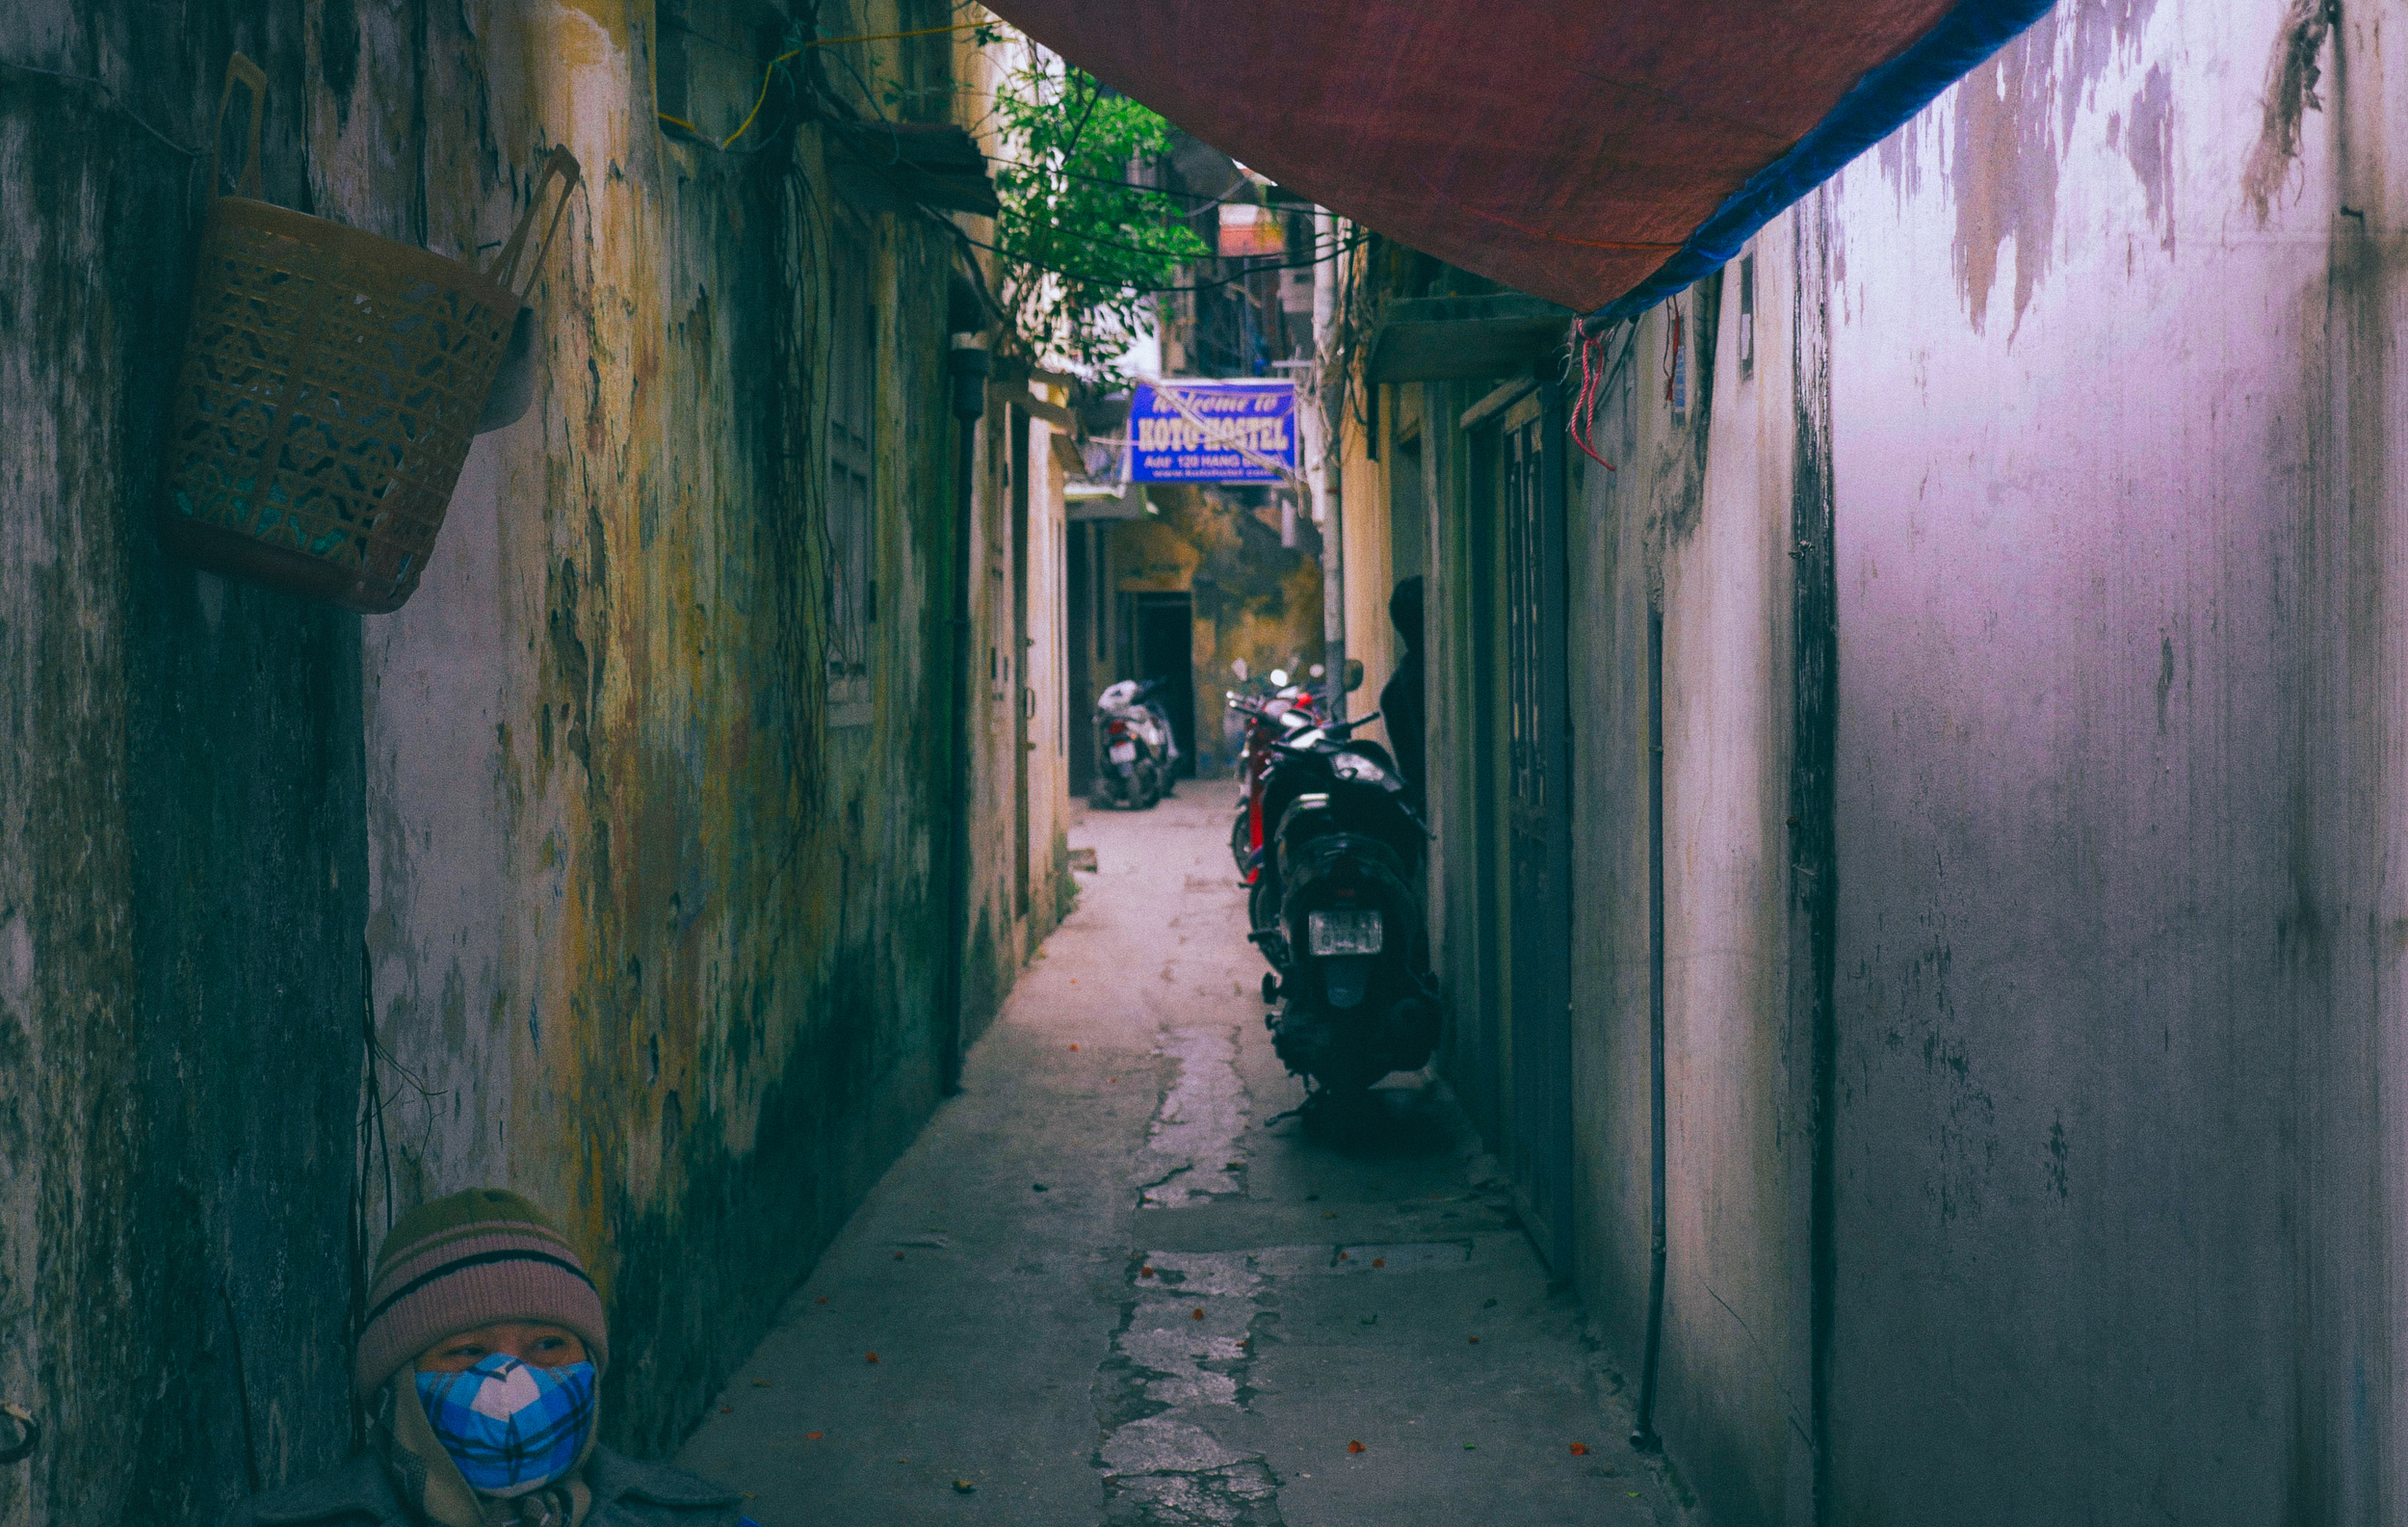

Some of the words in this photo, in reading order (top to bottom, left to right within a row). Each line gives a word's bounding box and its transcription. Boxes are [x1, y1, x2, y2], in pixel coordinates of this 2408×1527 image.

[1152, 390, 1249, 413] Wlcome
[1254, 393, 1279, 412] to
[1177, 455, 1200, 468] 120
[1201, 455, 1241, 468] HANG
